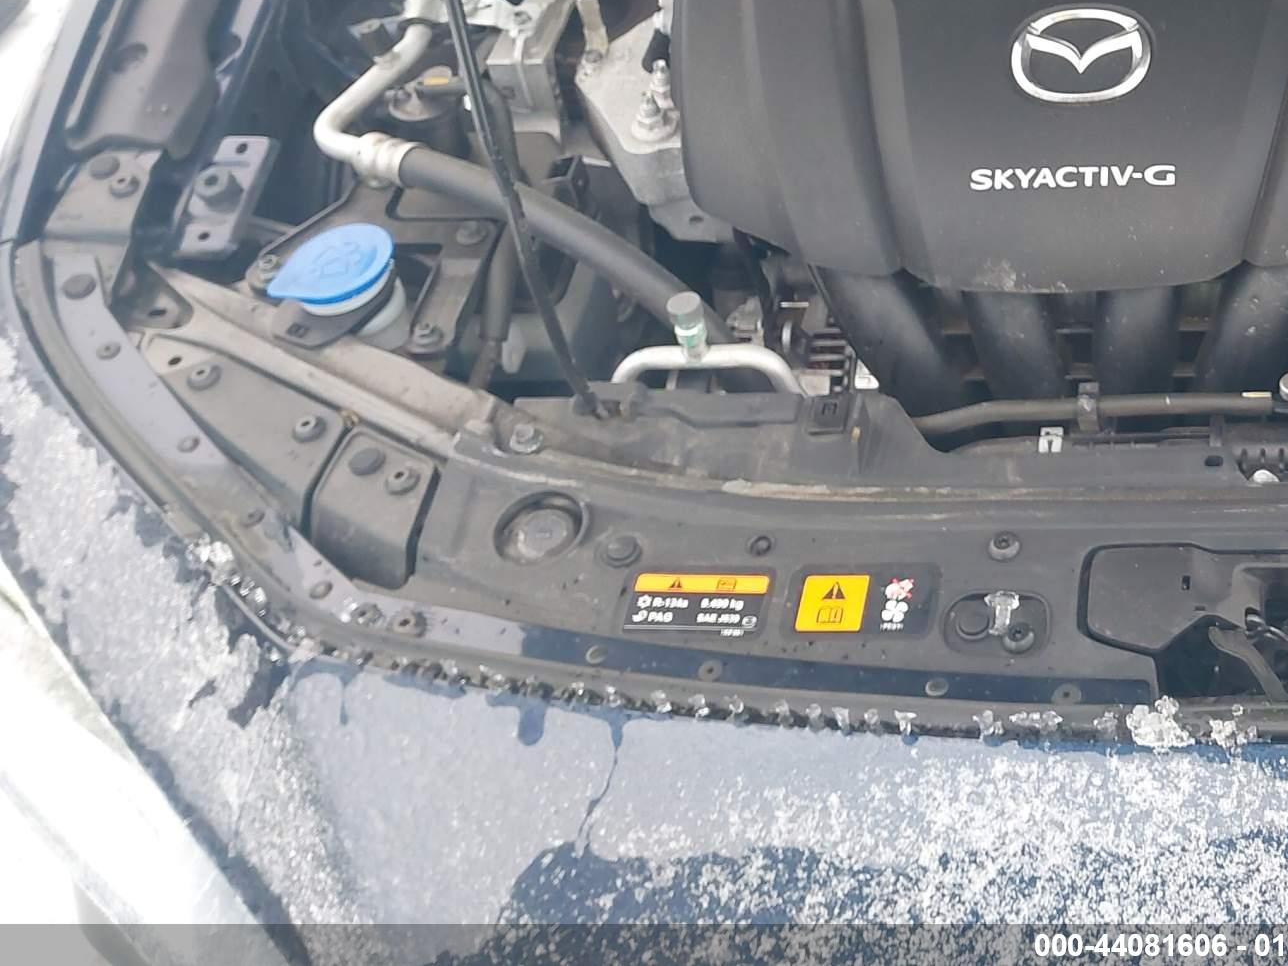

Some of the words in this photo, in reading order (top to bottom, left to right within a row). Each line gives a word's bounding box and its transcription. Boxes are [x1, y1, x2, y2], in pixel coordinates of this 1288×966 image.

[970, 165, 1176, 191] SKYACTIV-G
[652, 597, 688, 608] R-134a
[731, 599, 744, 611] kg
[648, 611, 673, 622] PAG
